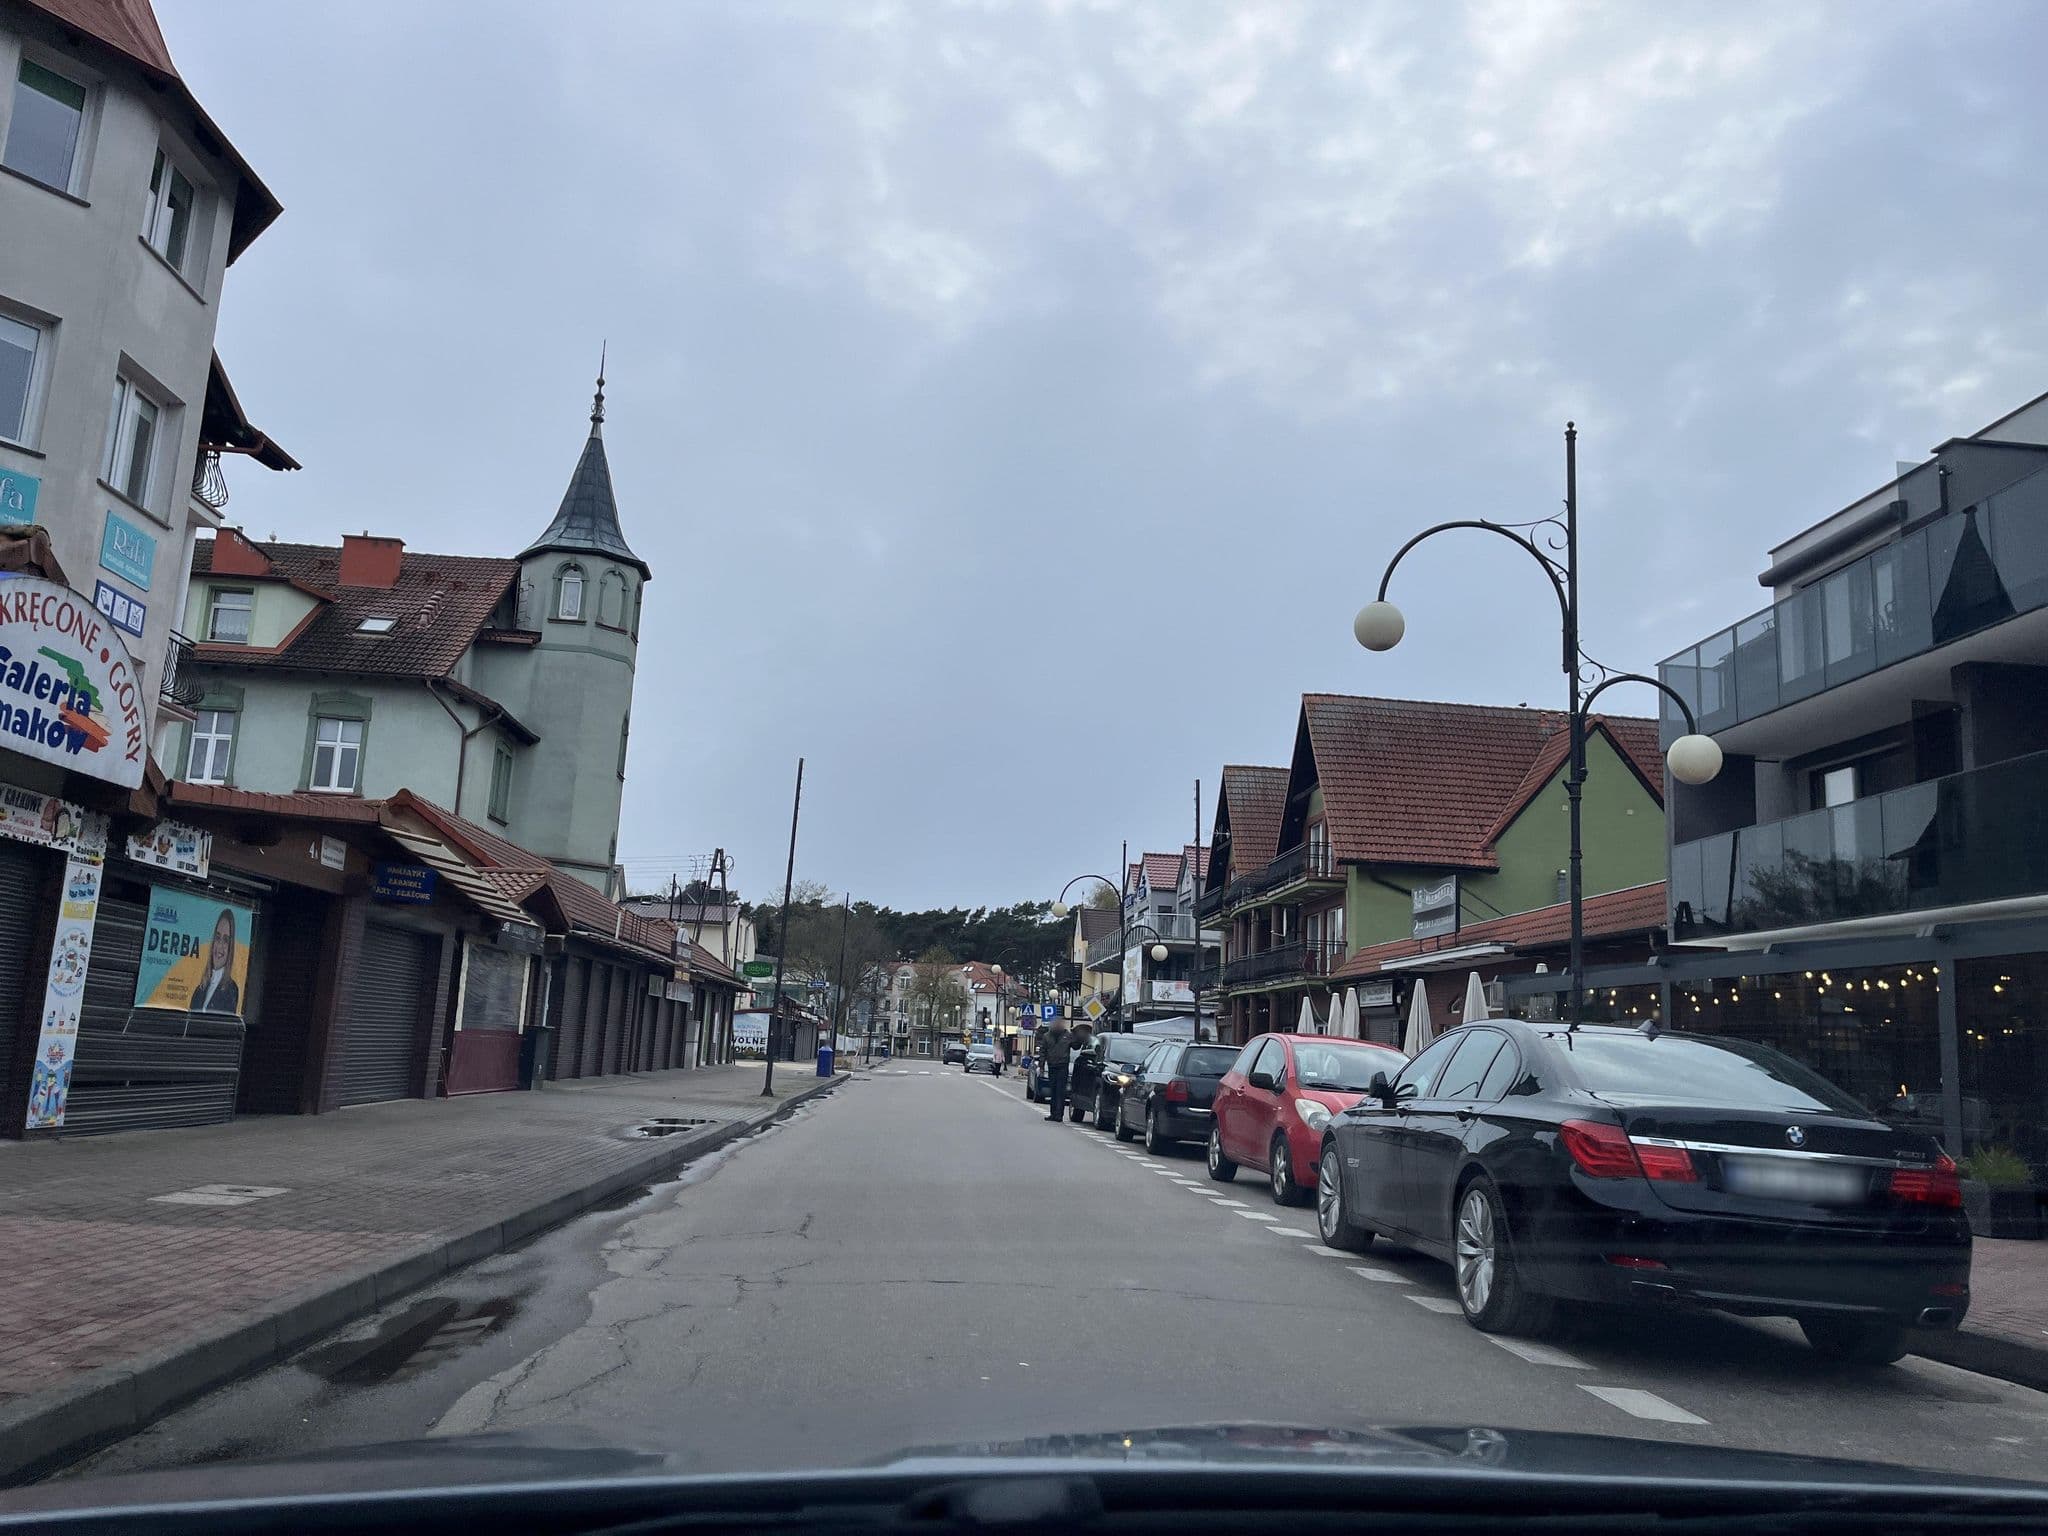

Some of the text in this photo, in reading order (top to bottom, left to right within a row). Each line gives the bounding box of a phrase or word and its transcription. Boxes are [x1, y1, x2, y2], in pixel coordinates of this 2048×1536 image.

[0, 591, 101, 653] KRĘCONE
[109, 662, 142, 762] GOFRY
[147, 927, 200, 959] DERBA
[1044, 1006, 1054, 1019] P
